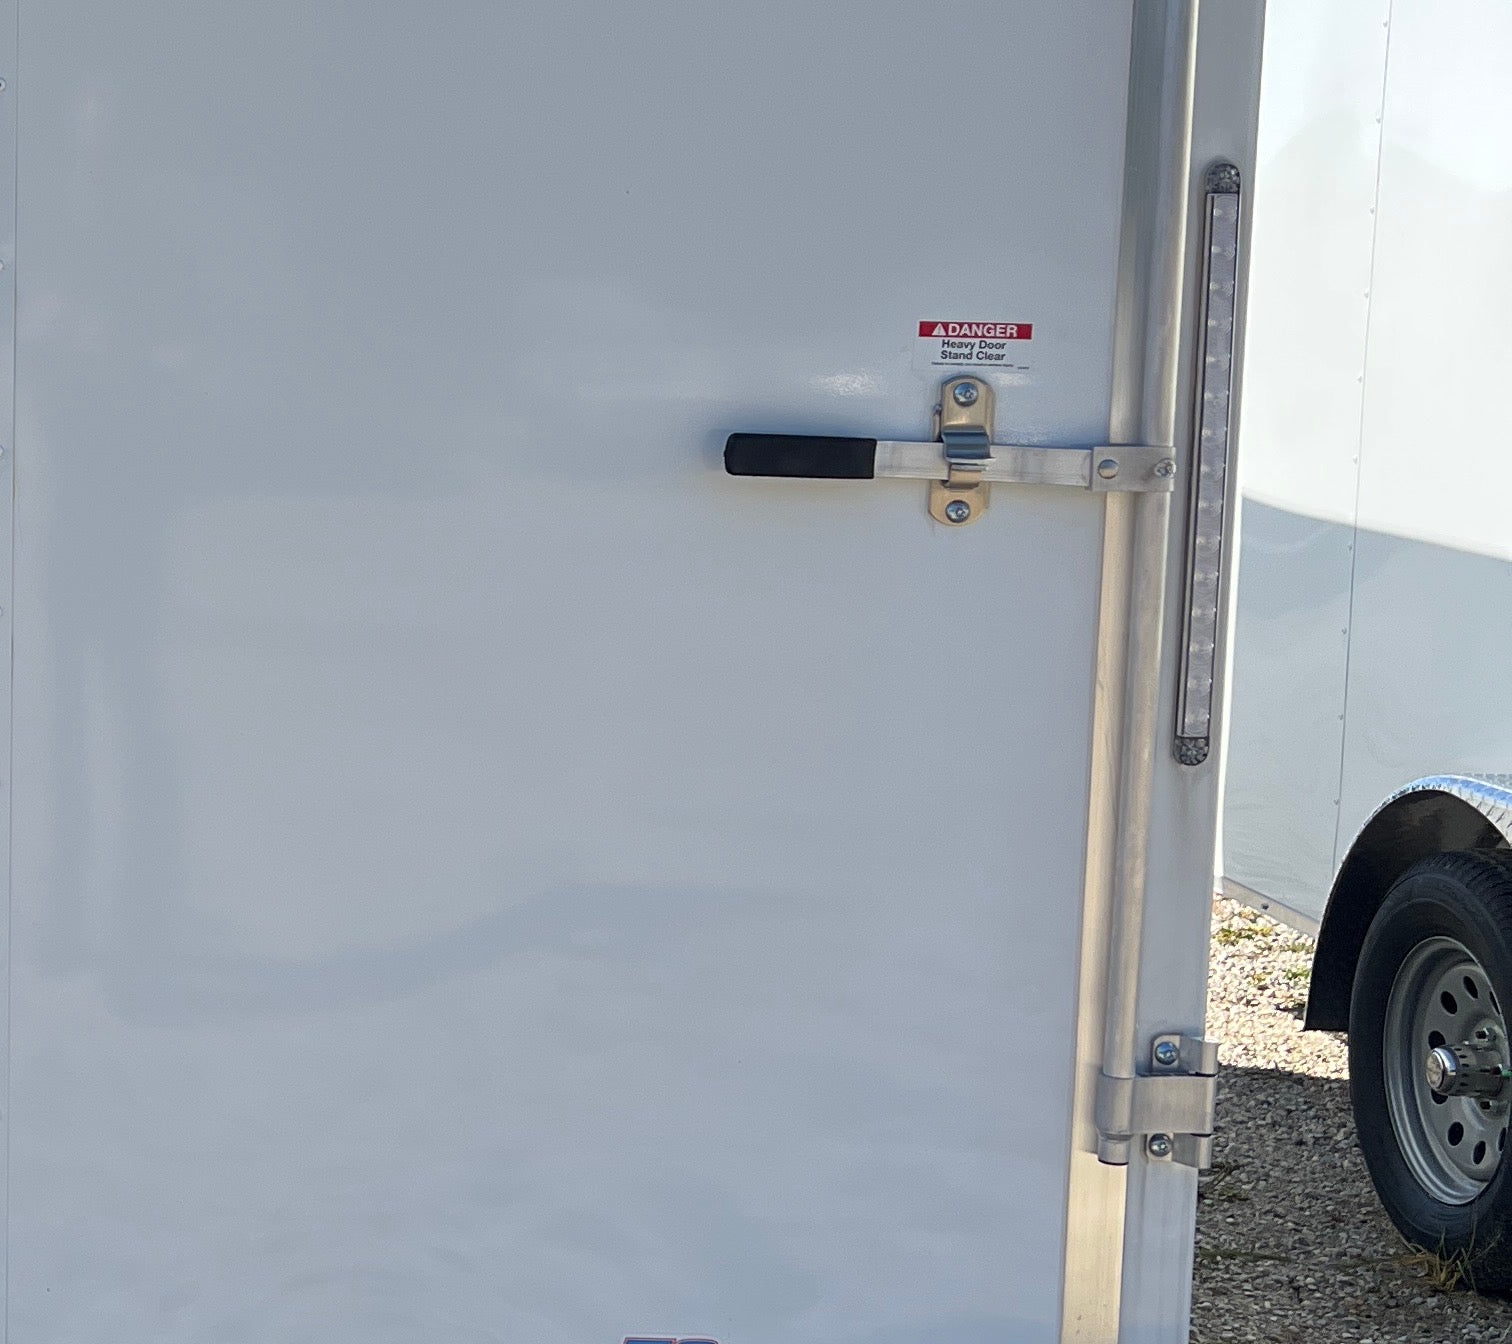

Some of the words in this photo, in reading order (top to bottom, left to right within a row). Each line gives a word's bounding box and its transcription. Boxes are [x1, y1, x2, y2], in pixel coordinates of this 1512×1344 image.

[947, 323, 1018, 337] DANGER
[941, 339, 976, 351] Heavy
[978, 340, 1007, 349] Door
[940, 350, 973, 360] Stand
[976, 350, 1006, 361] Clear
